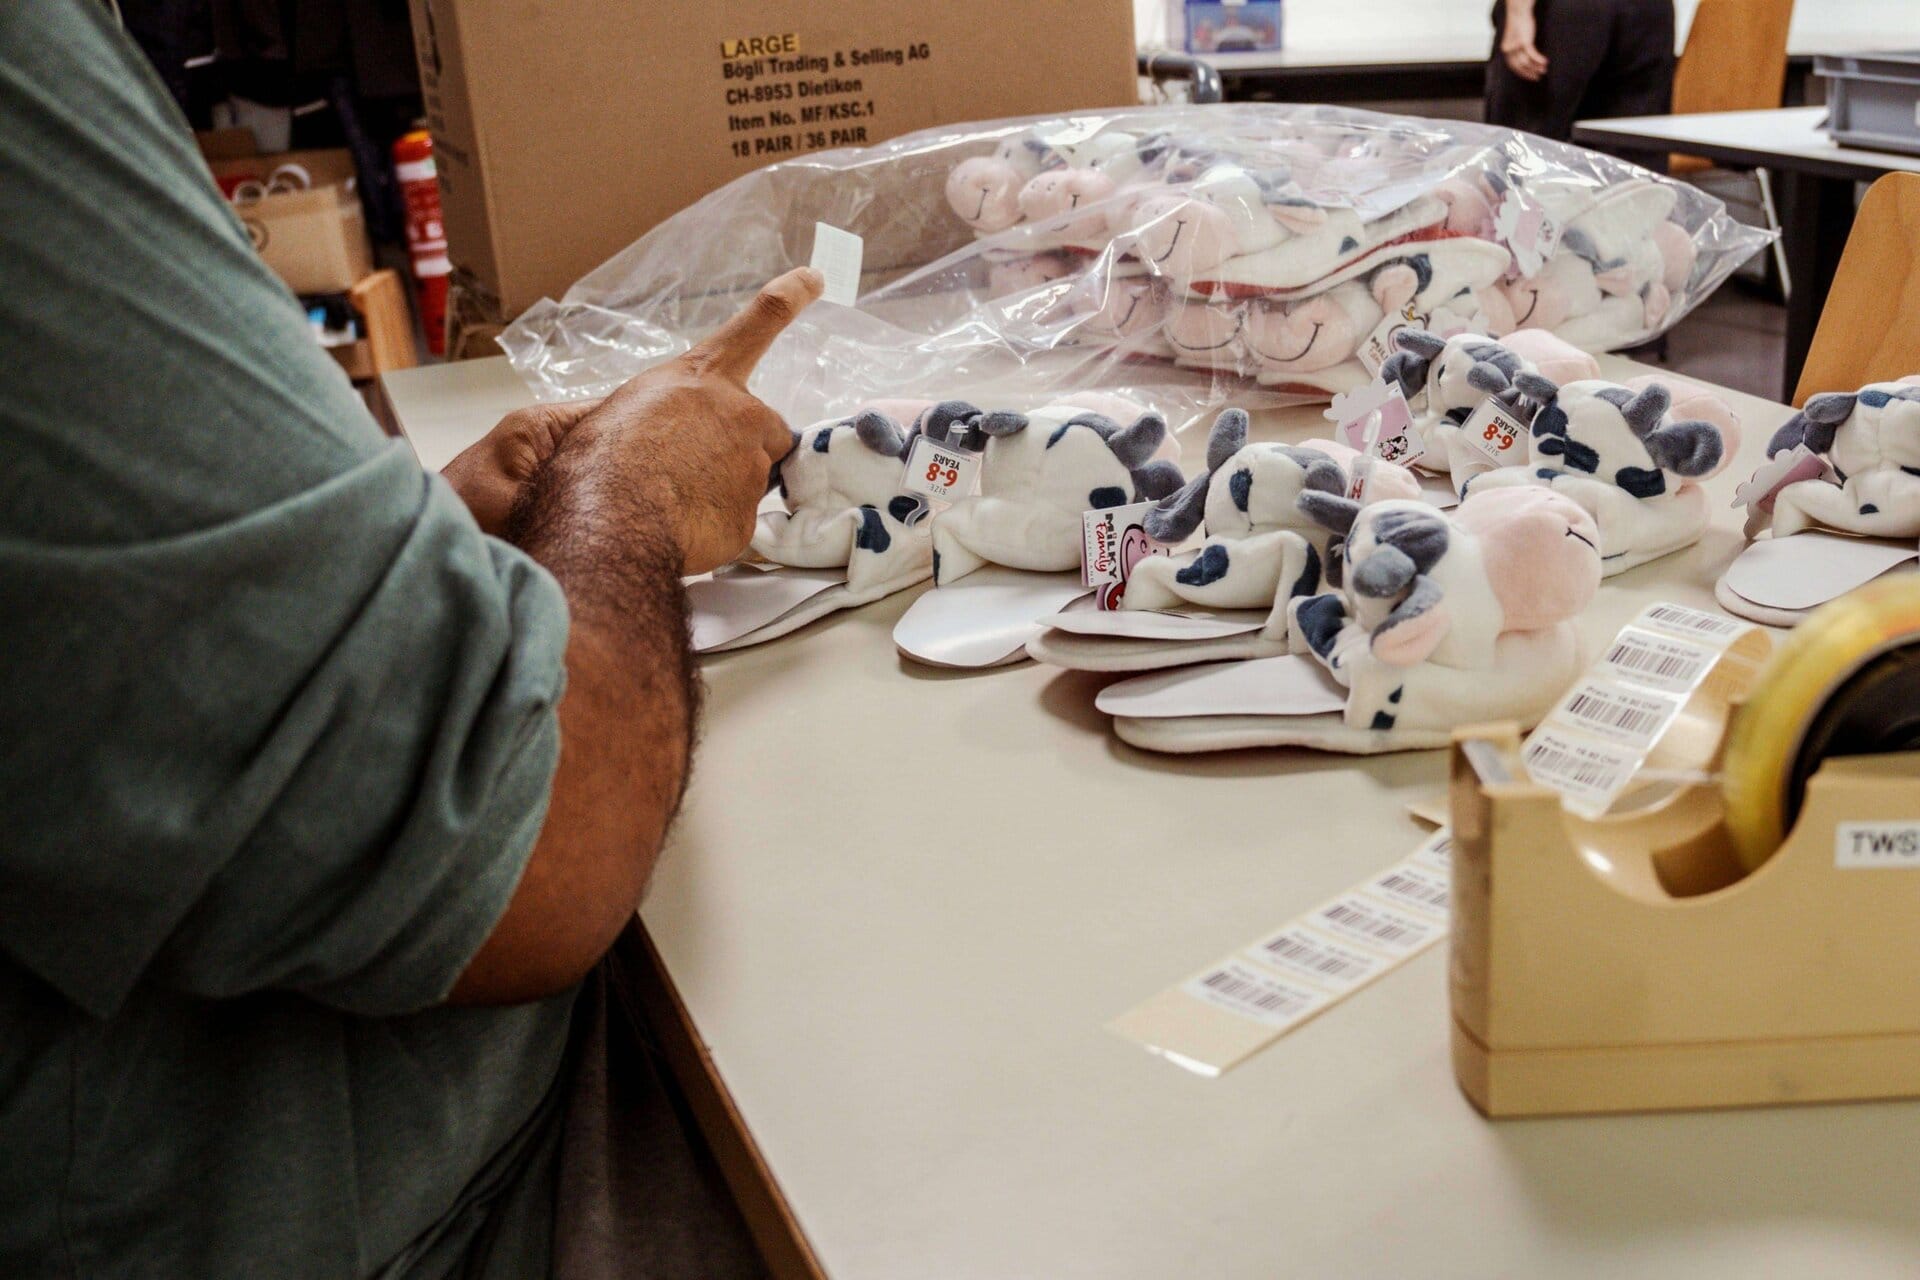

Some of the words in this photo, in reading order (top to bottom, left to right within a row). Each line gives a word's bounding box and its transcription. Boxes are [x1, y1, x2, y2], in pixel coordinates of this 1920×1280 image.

[721, 34, 796, 59] LARGE
[768, 56, 828, 73] Trading
[834, 51, 845, 67] &
[851, 48, 903, 66] Selling
[908, 43, 930, 60] AG
[727, 83, 793, 104] CH-8953
[798, 79, 862, 97] Dietikon
[729, 115, 765, 131] Item
[769, 110, 796, 126] No.
[801, 100, 874, 123] MF/KSC.1
[732, 141, 750, 157] 18
[755, 135, 793, 153] PAIR
[806, 132, 825, 149] 36
[831, 126, 867, 144] PAIR
[1483, 424, 1514, 450] 6-8
[1493, 416, 1518, 438] YEARS
[932, 453, 960, 471] YEARS
[926, 463, 958, 487] 6-8
[929, 483, 947, 496] SIZE
[1094, 522, 1111, 572] Family
